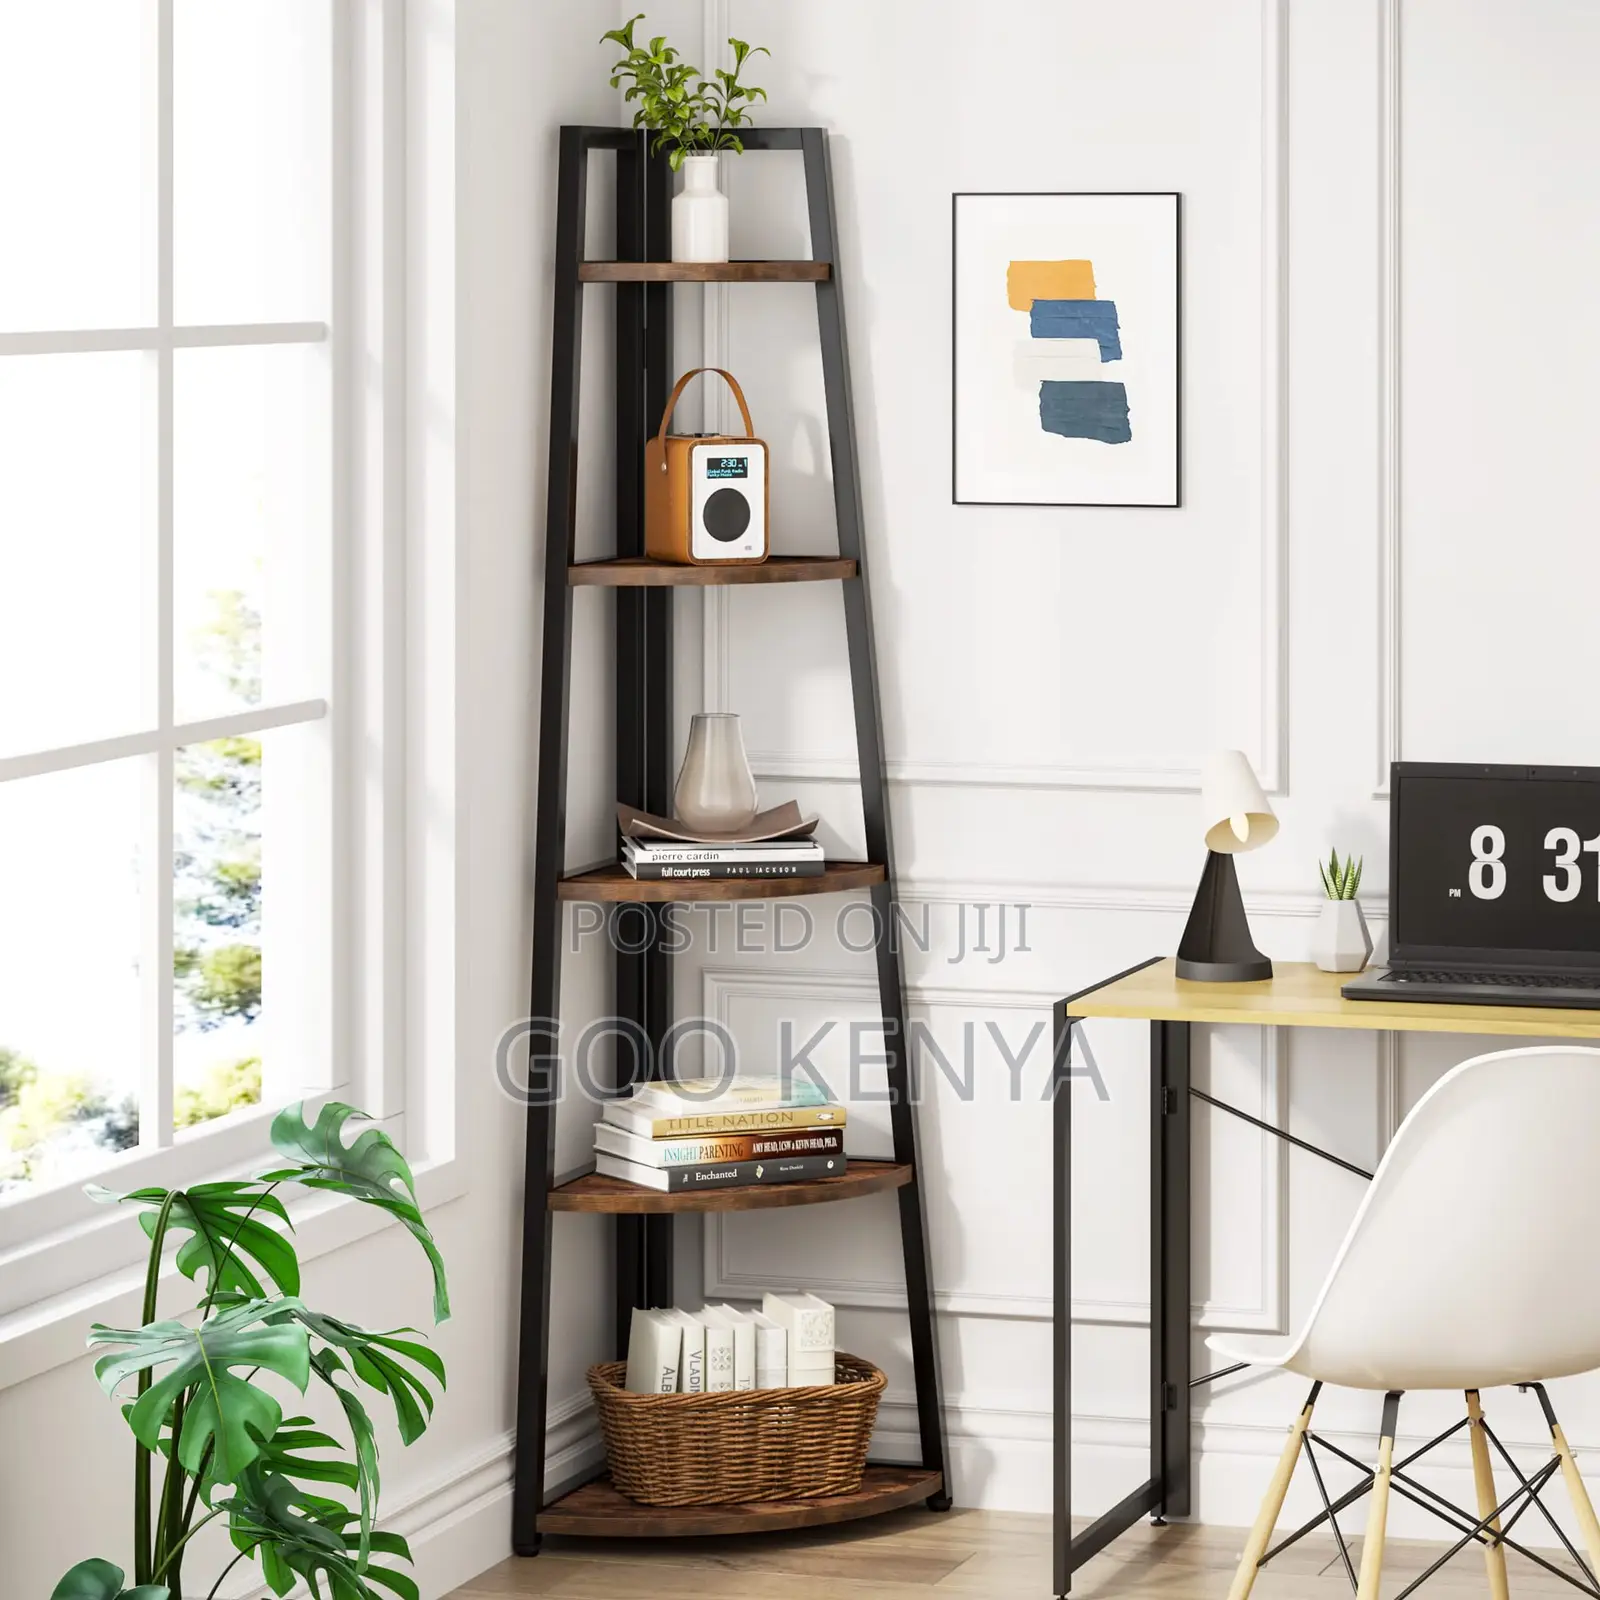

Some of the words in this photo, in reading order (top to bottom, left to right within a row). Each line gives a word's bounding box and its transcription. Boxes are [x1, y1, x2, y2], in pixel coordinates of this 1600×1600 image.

[652, 853, 683, 862] pierre
[686, 851, 720, 861] cardin
[1449, 888, 1461, 898] PM
[1468, 824, 1507, 900] 8
[661, 867, 673, 877] full
[673, 867, 692, 877] court
[692, 868, 711, 878] press
[755, 866, 797, 874] JACKSON
[668, 1116, 714, 1130] TITLE
[722, 1111, 795, 1127] NATION
[664, 1145, 698, 1162] INSIGHT
[699, 1142, 744, 1160] PARENTING
[752, 1142, 763, 1154] AMY
[795, 1138, 810, 1150] KEVIN
[695, 1168, 738, 1181] Enchanted
